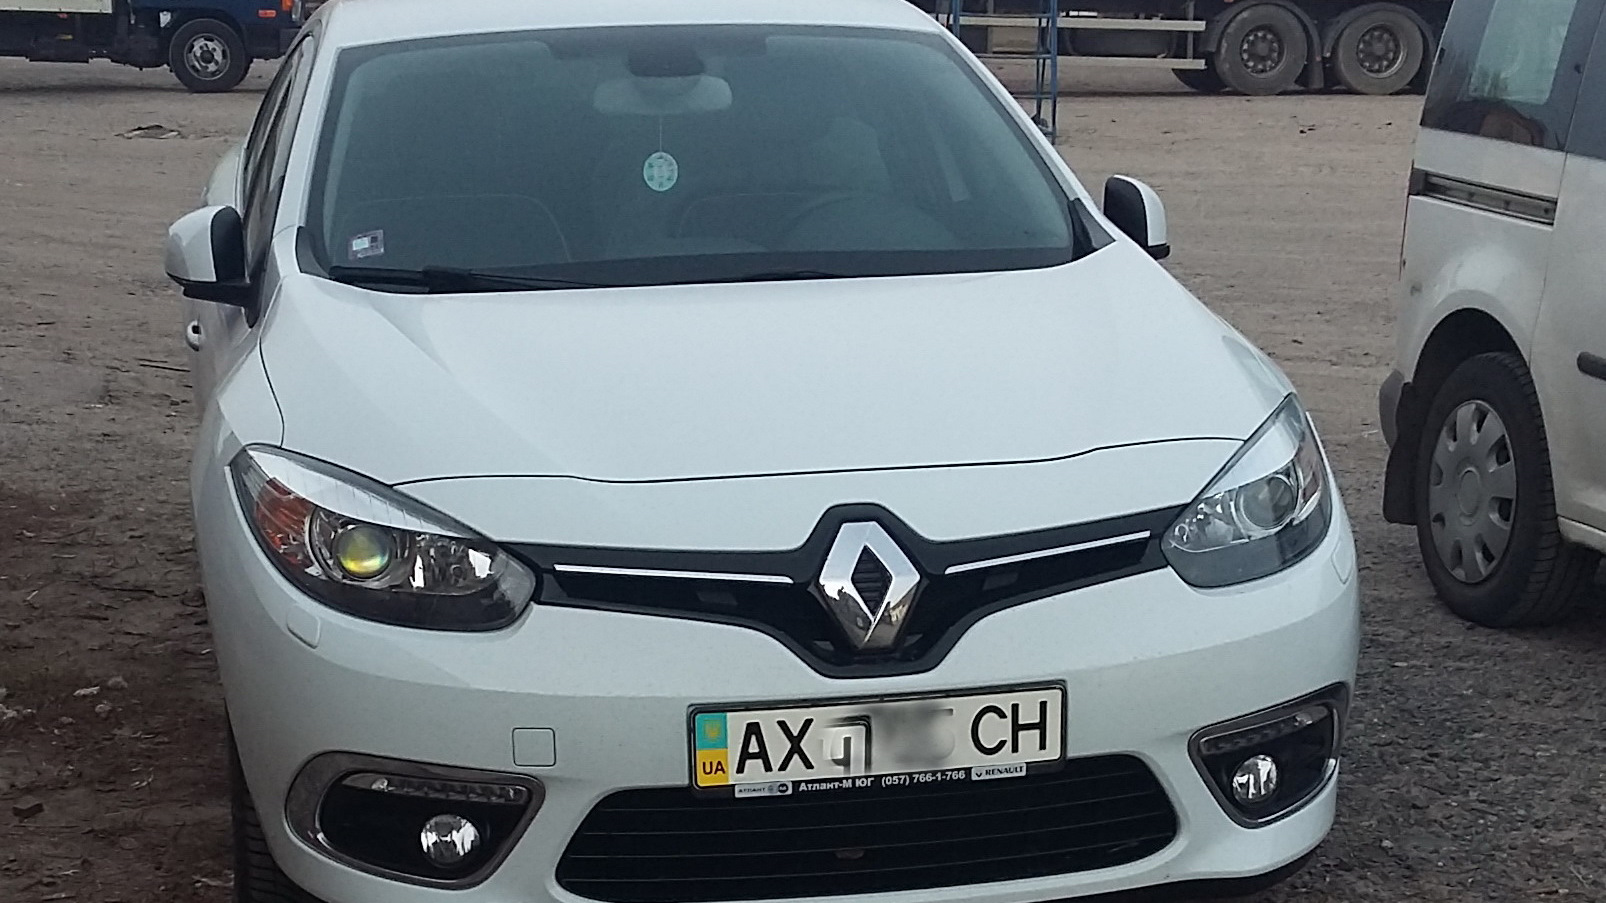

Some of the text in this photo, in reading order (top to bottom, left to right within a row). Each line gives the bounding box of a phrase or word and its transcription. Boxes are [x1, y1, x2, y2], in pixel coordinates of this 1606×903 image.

[735, 717, 815, 775] AX
[970, 701, 1047, 756] CH
[702, 760, 726, 775] UA
[985, 766, 1024, 776] RENAULT
[799, 779, 852, 791] Атлант-М
[856, 778, 874, 787] ЮГ
[881, 775, 910, 787] (057)
[912, 771, 966, 783] 766-1-766
